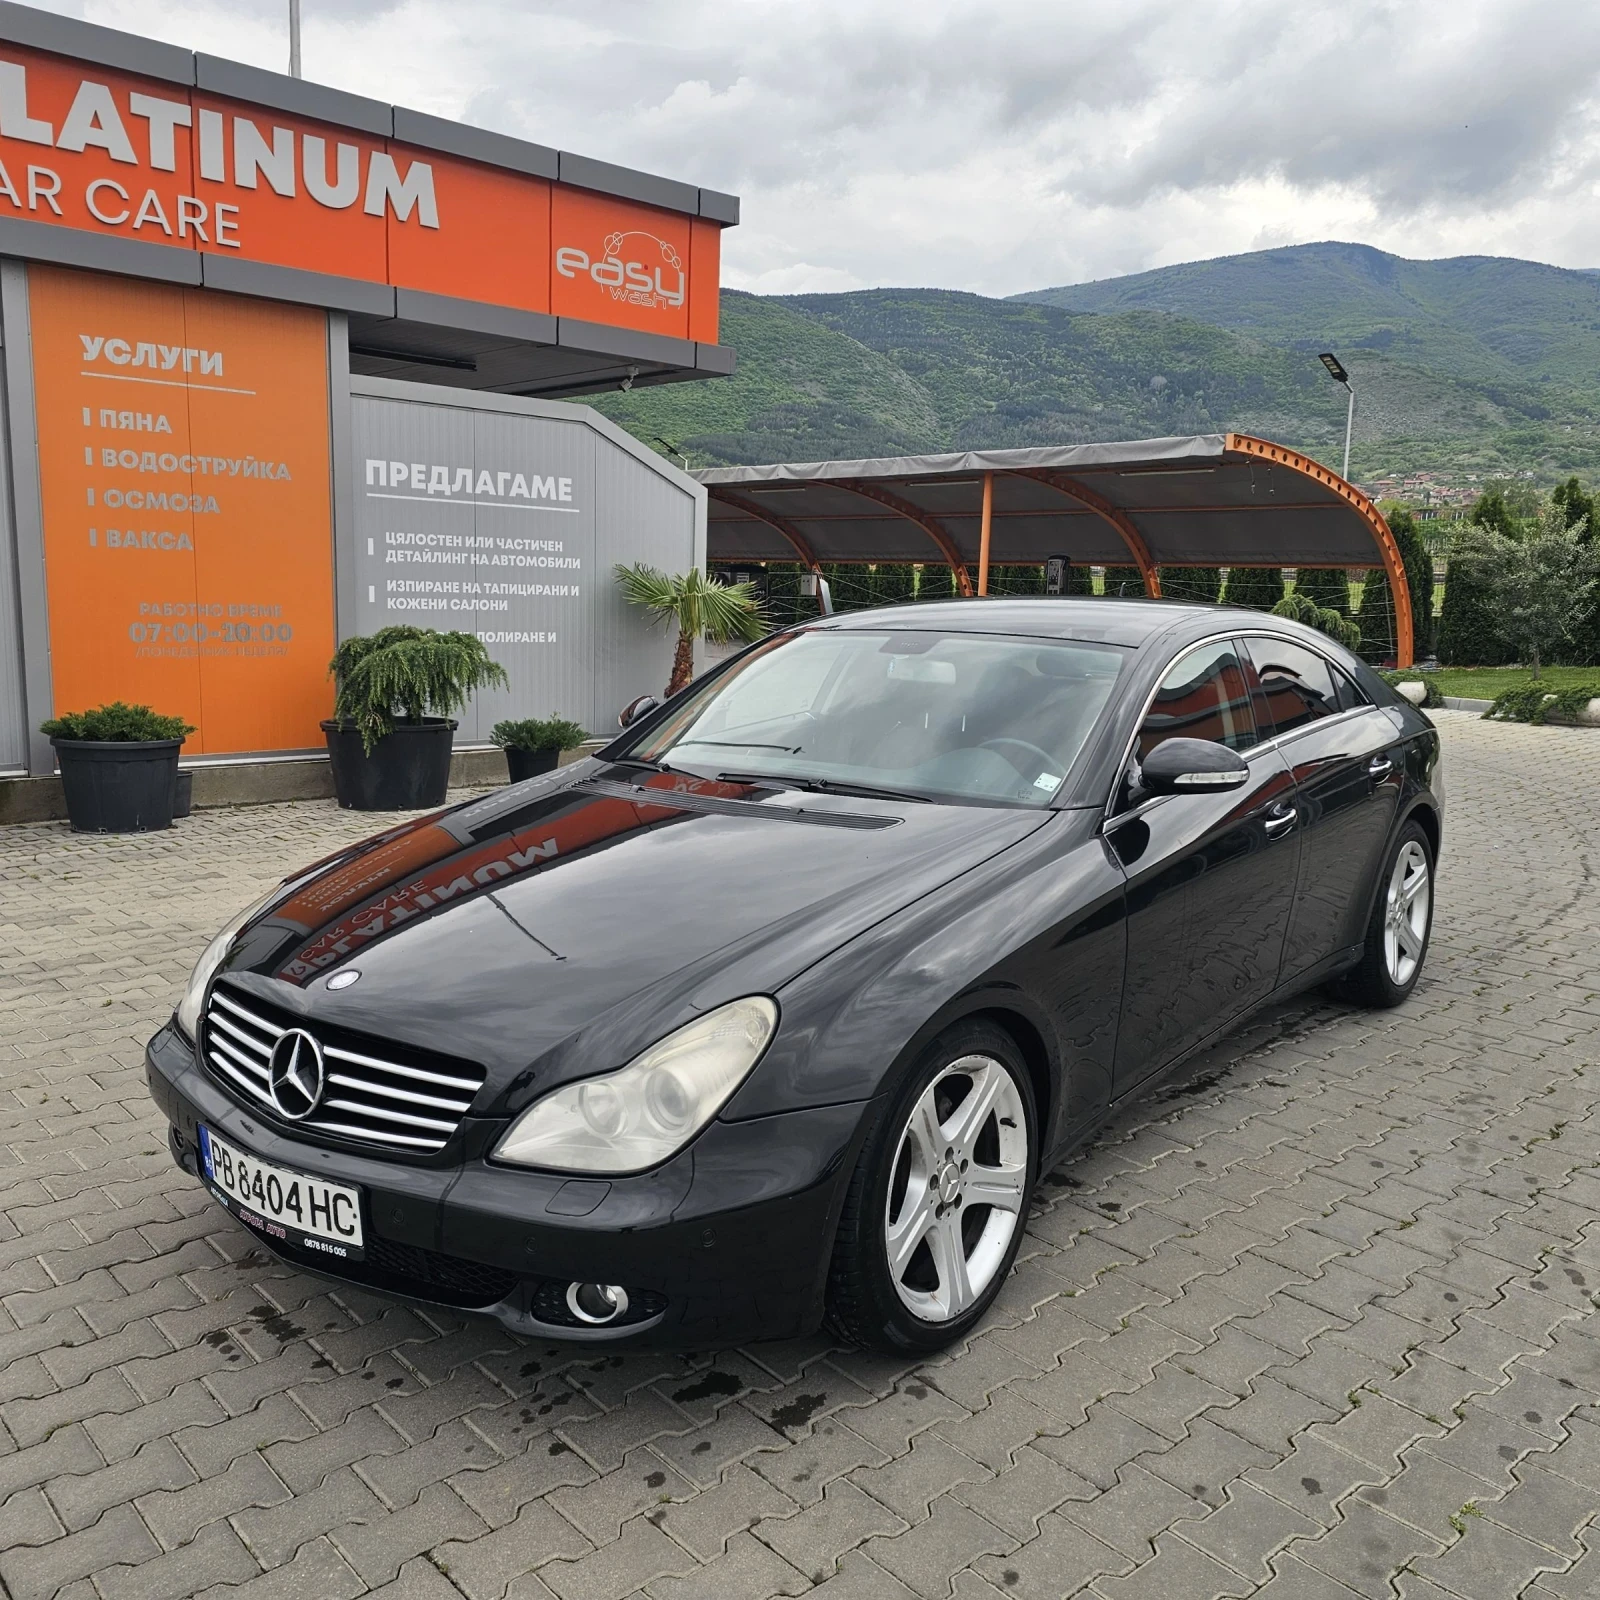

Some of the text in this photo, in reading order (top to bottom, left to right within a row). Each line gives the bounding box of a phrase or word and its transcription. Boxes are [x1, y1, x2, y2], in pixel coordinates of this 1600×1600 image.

[86, 178, 241, 248] CARE
[556, 247, 685, 306] easy
[610, 286, 667, 310] wash
[79, 334, 223, 377] УСЛУГИ
[100, 408, 172, 434] ПЯНА
[102, 448, 292, 481] ВОДОСТРУЙКА
[366, 459, 572, 502] ПРЕДЛАГАМЕ
[104, 488, 221, 514] ОСМОЗА
[106, 529, 194, 551] ВАКСА
[385, 531, 563, 552] ЦЯЛОСТЕН ИЛИ ЧАСТИЧЕН
[385, 548, 581, 569] ДЕТАЙЛИНГ НА АВТОМОБИЛИ
[386, 579, 580, 597] ИЗПИРАНЕ НА ТАПИЦИРАНИ И
[139, 602, 282, 618] РАБОТНО ВРЕМЕ
[387, 597, 508, 611] КОЖЕНИ САЛОНИ
[128, 621, 293, 643] 07:00-20:00
[476, 631, 545, 643] ПОЛИРАНЕ
[547, 632, 557, 643] И
[211, 1138, 235, 1190] PB
[237, 1160, 303, 1224] 8404
[308, 1185, 355, 1237] HC
[304, 1238, 347, 1257] 0878 815 005
